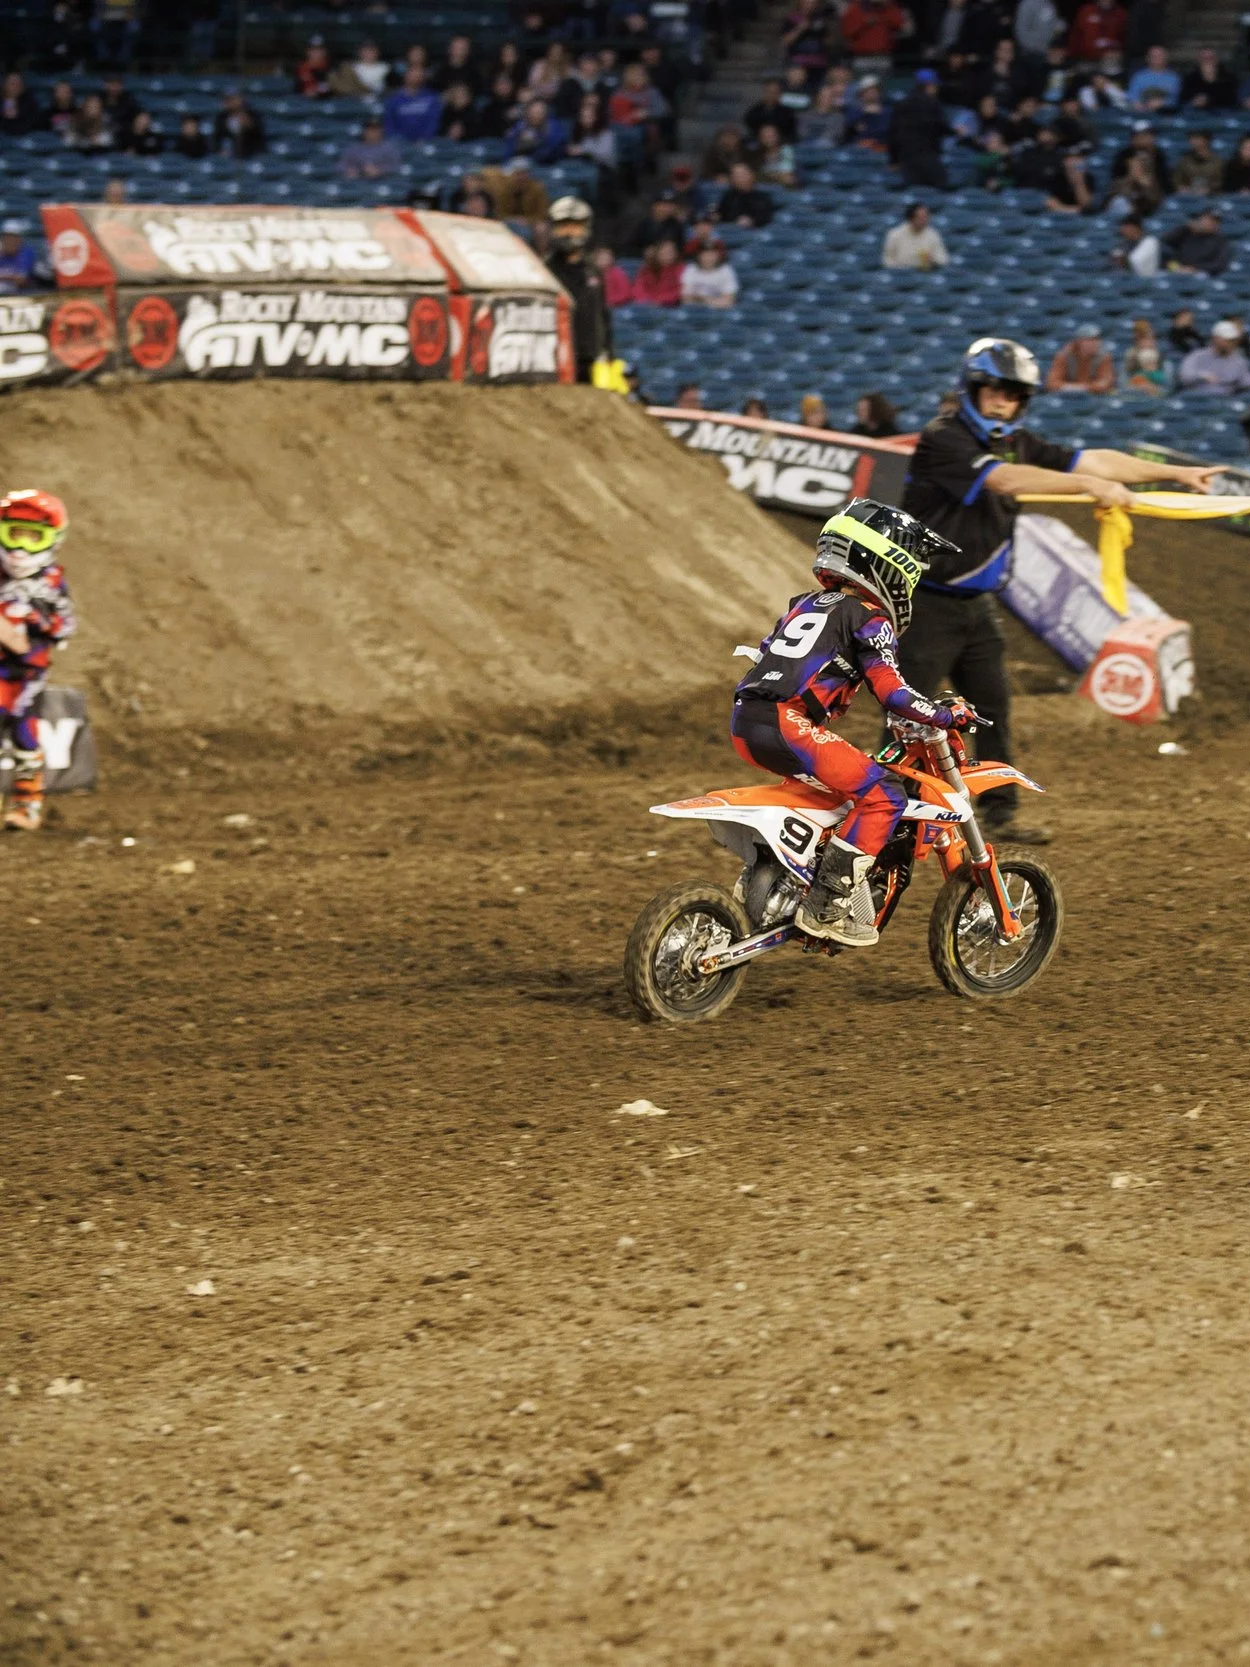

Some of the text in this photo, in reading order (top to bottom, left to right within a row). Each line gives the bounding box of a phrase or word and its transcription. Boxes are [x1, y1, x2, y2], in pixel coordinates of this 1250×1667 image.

[686, 420, 858, 472] MOUNTAIN
[883, 545, 921, 584] 100%
[769, 612, 829, 659] 9
[779, 816, 814, 855] 9
[935, 811, 963, 822] KTM
